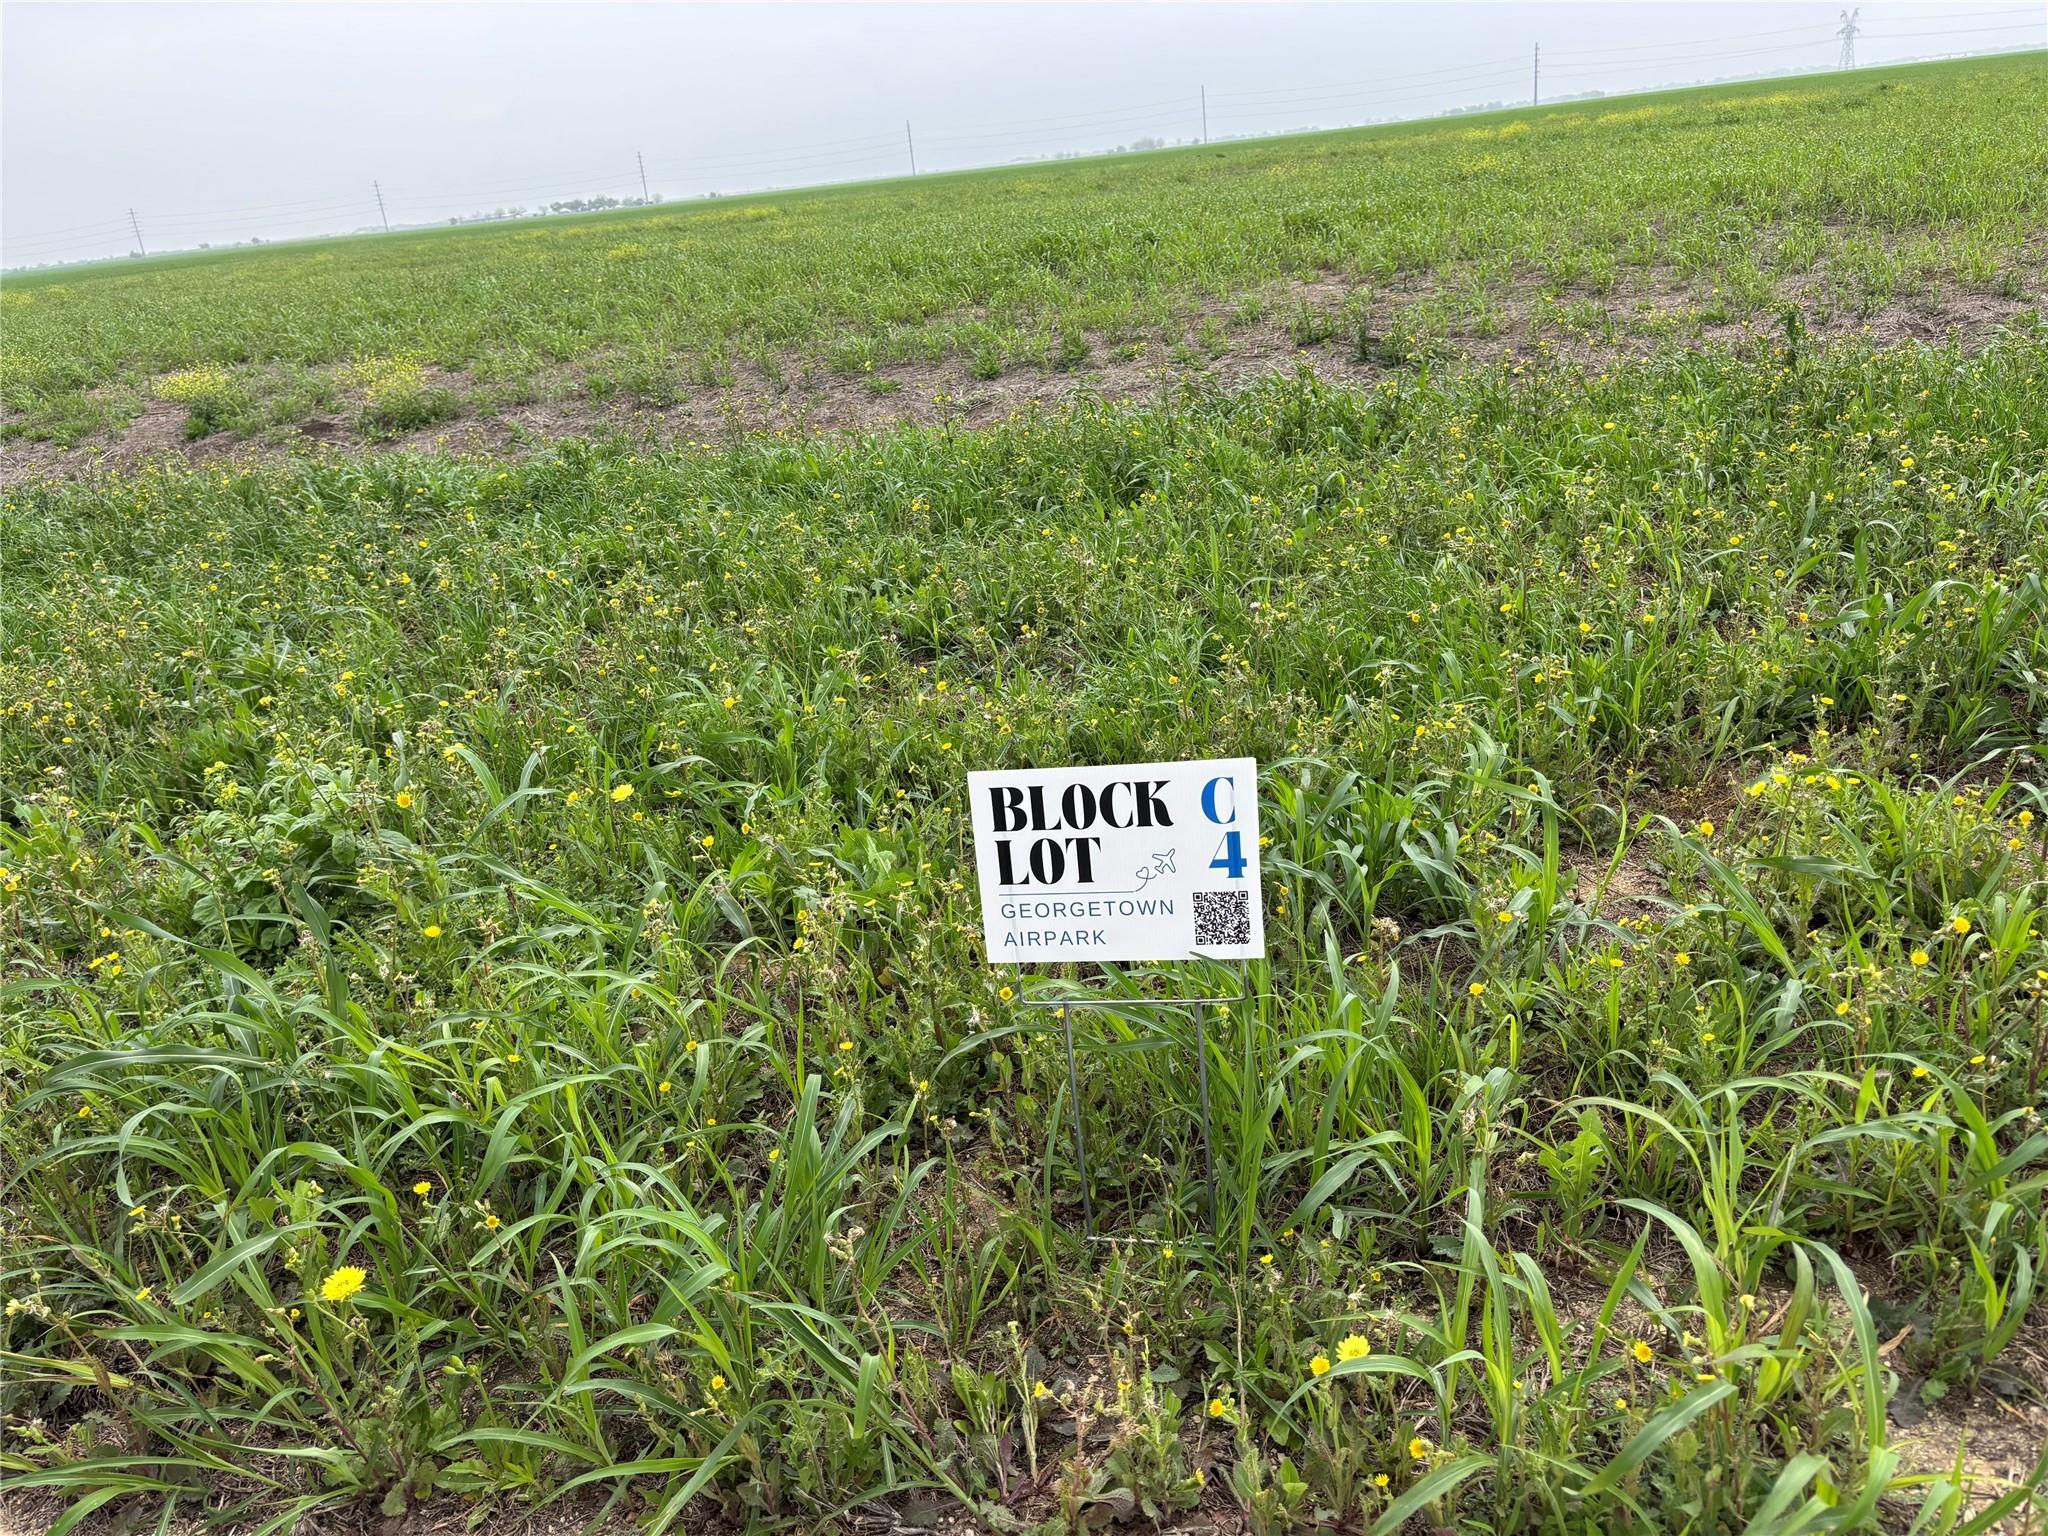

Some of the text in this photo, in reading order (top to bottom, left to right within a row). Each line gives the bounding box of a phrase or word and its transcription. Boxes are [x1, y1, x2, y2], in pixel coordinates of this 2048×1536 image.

[988, 776, 1236, 833] BLOCK C
[994, 830, 1248, 886] LOT 4
[1000, 899, 1175, 919] GEORGETOWN
[1003, 929, 1107, 947] AIRPARK
